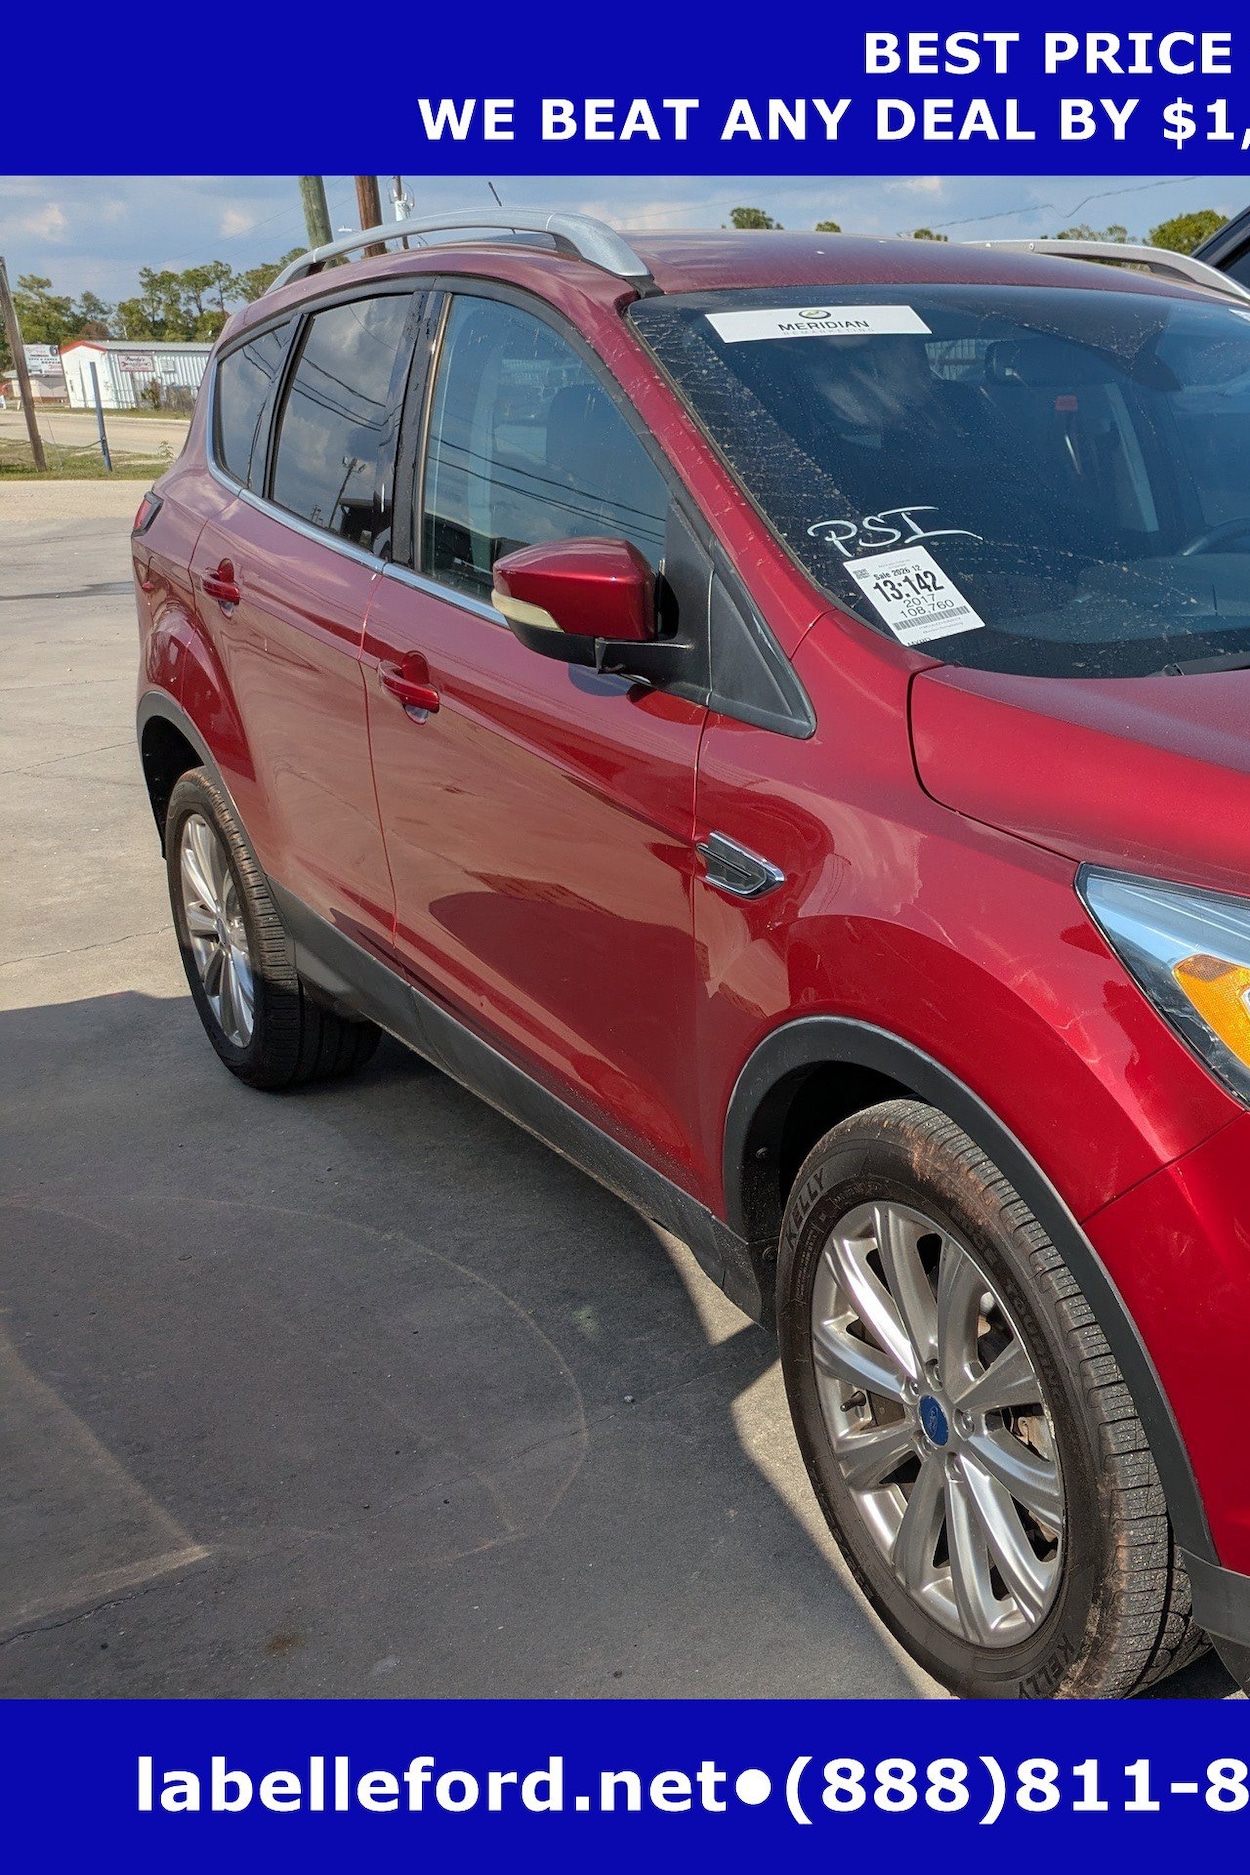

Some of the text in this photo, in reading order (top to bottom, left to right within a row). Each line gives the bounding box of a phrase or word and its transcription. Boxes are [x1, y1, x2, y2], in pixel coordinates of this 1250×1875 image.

[778, 320, 870, 332] MERIDIAN
[807, 506, 984, 558] PSI
[873, 571, 892, 580] Sale
[872, 570, 945, 603] 13:142
[900, 599, 955, 619] 108,760
[903, 593, 937, 608] 2017
